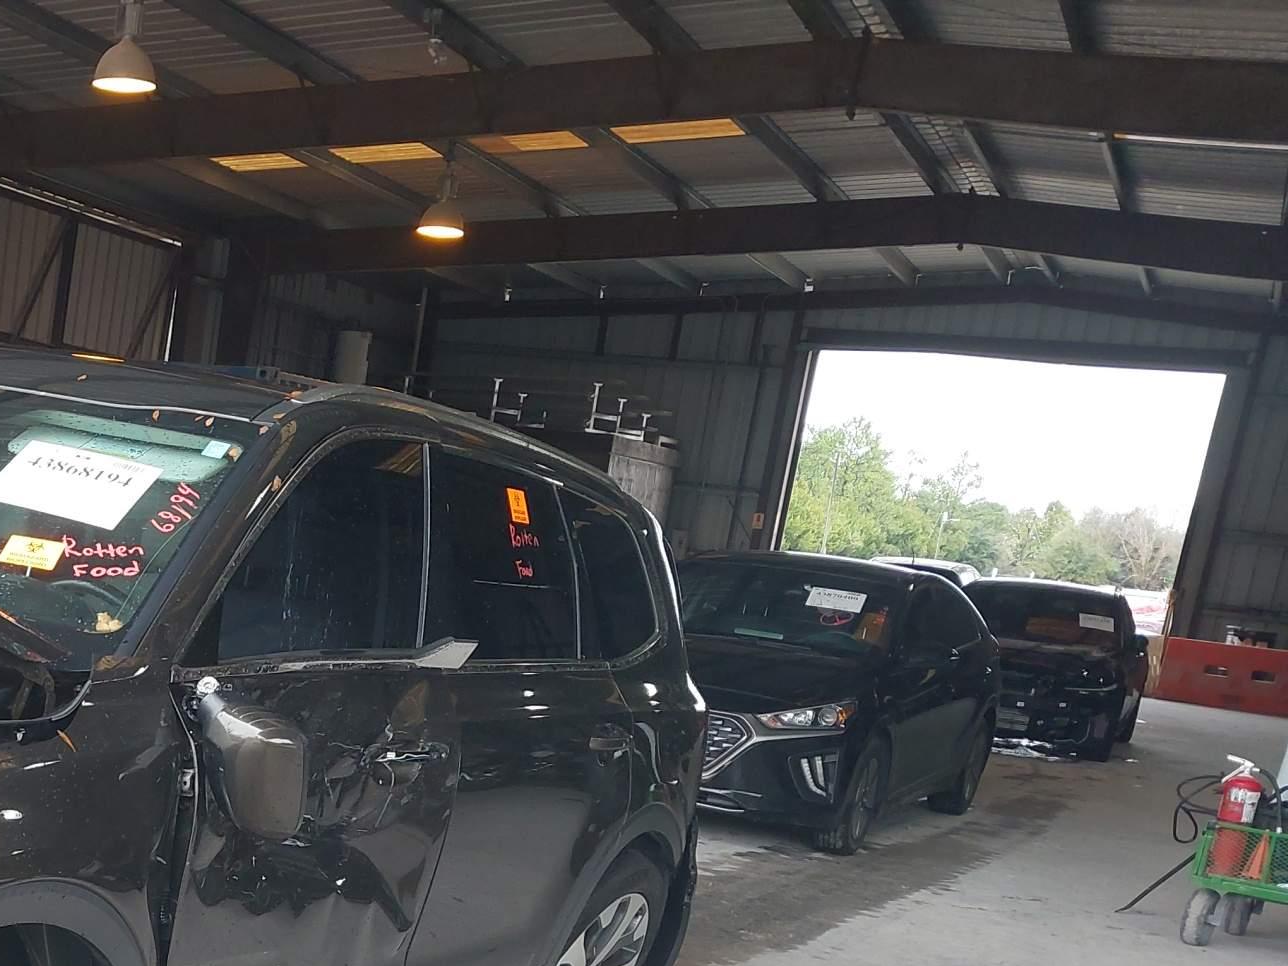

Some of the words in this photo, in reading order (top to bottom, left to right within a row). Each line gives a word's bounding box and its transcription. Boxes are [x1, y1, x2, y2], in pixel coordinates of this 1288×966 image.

[27, 456, 133, 488] 43868194
[150, 482, 201, 533] 68194
[62, 534, 144, 558] Rotten
